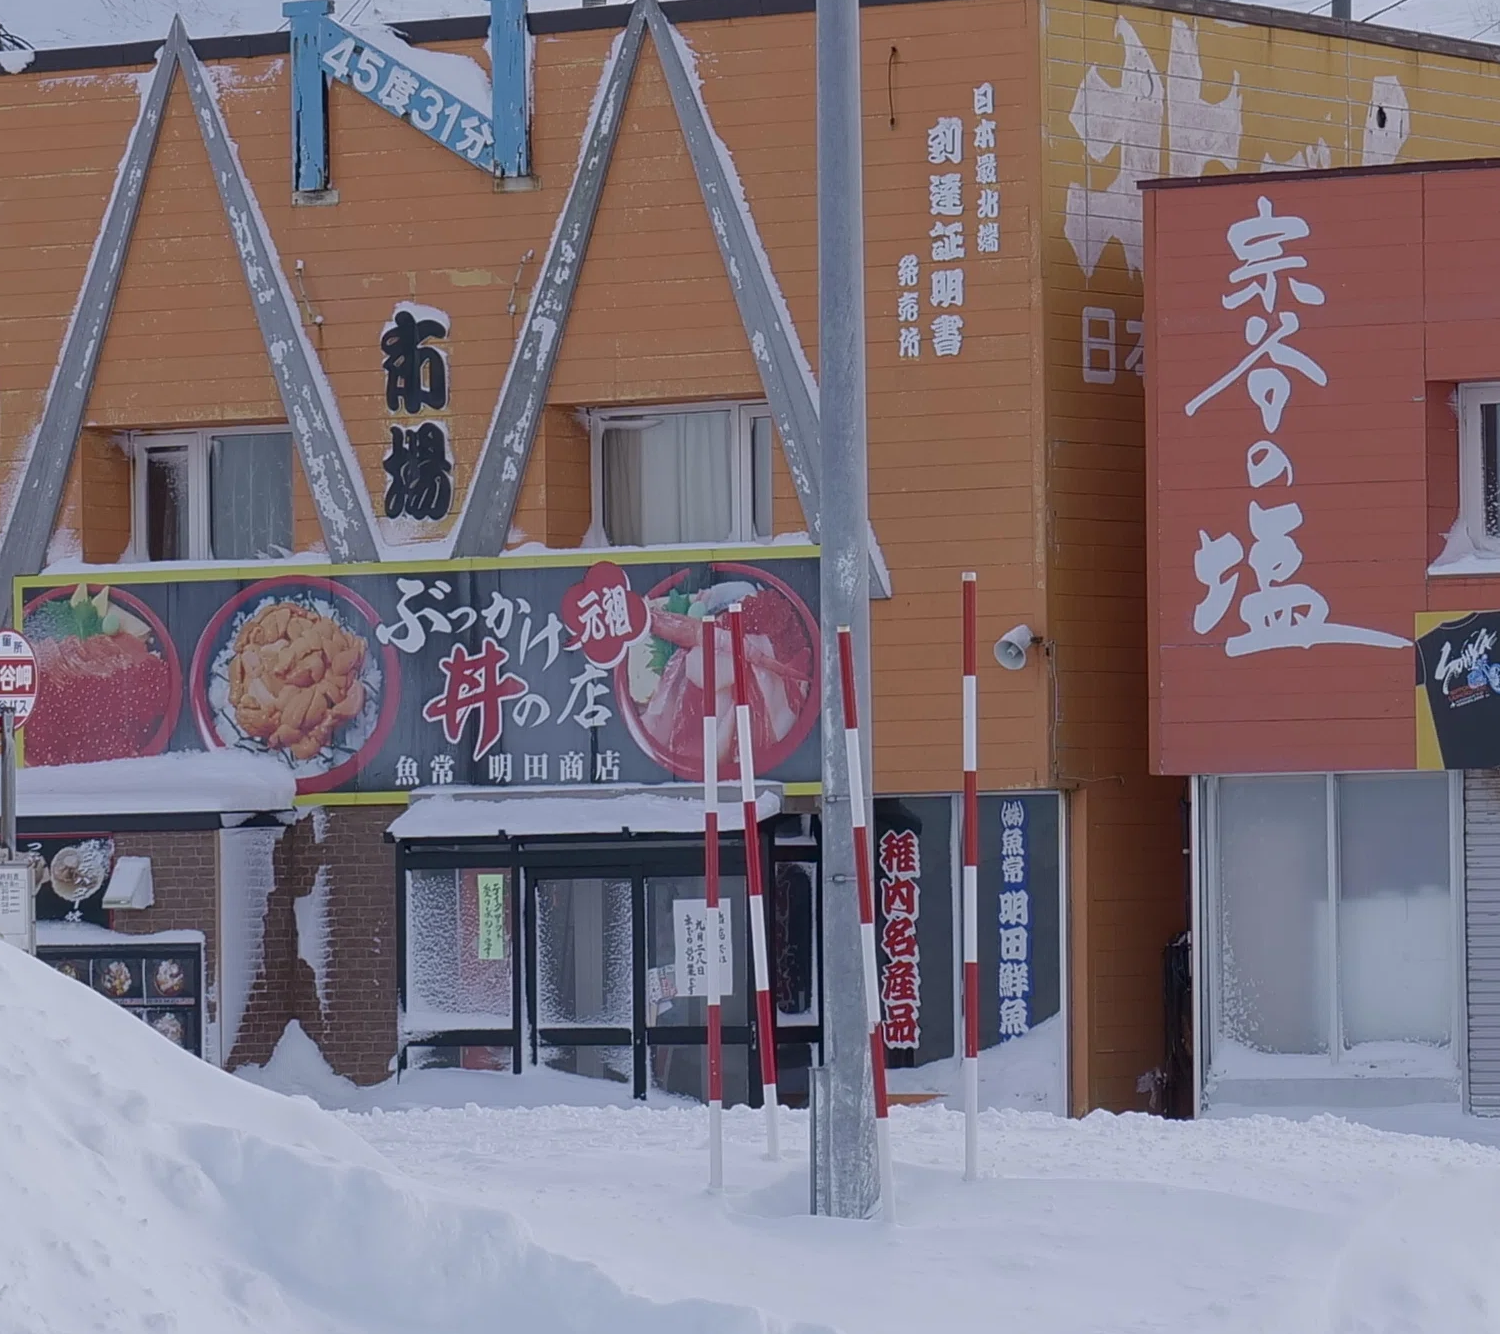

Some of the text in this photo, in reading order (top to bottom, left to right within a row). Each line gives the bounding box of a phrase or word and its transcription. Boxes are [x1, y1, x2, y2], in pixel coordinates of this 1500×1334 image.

[321, 37, 496, 160] 45度31分
[973, 82, 1000, 253] 日本最北端
[928, 116, 965, 357] 到達証明書
[381, 307, 455, 521] 市場
[1184, 195, 1414, 658] 宗谷の塩
[376, 578, 566, 671] ぶっかけ
[577, 585, 630, 644] 元祖
[395, 750, 621, 786] 魚常 明田商店
[424, 637, 614, 762] 丼の店
[880, 830, 921, 1048] 稚内名産品
[998, 889, 1029, 1041] 明田鮮魚
